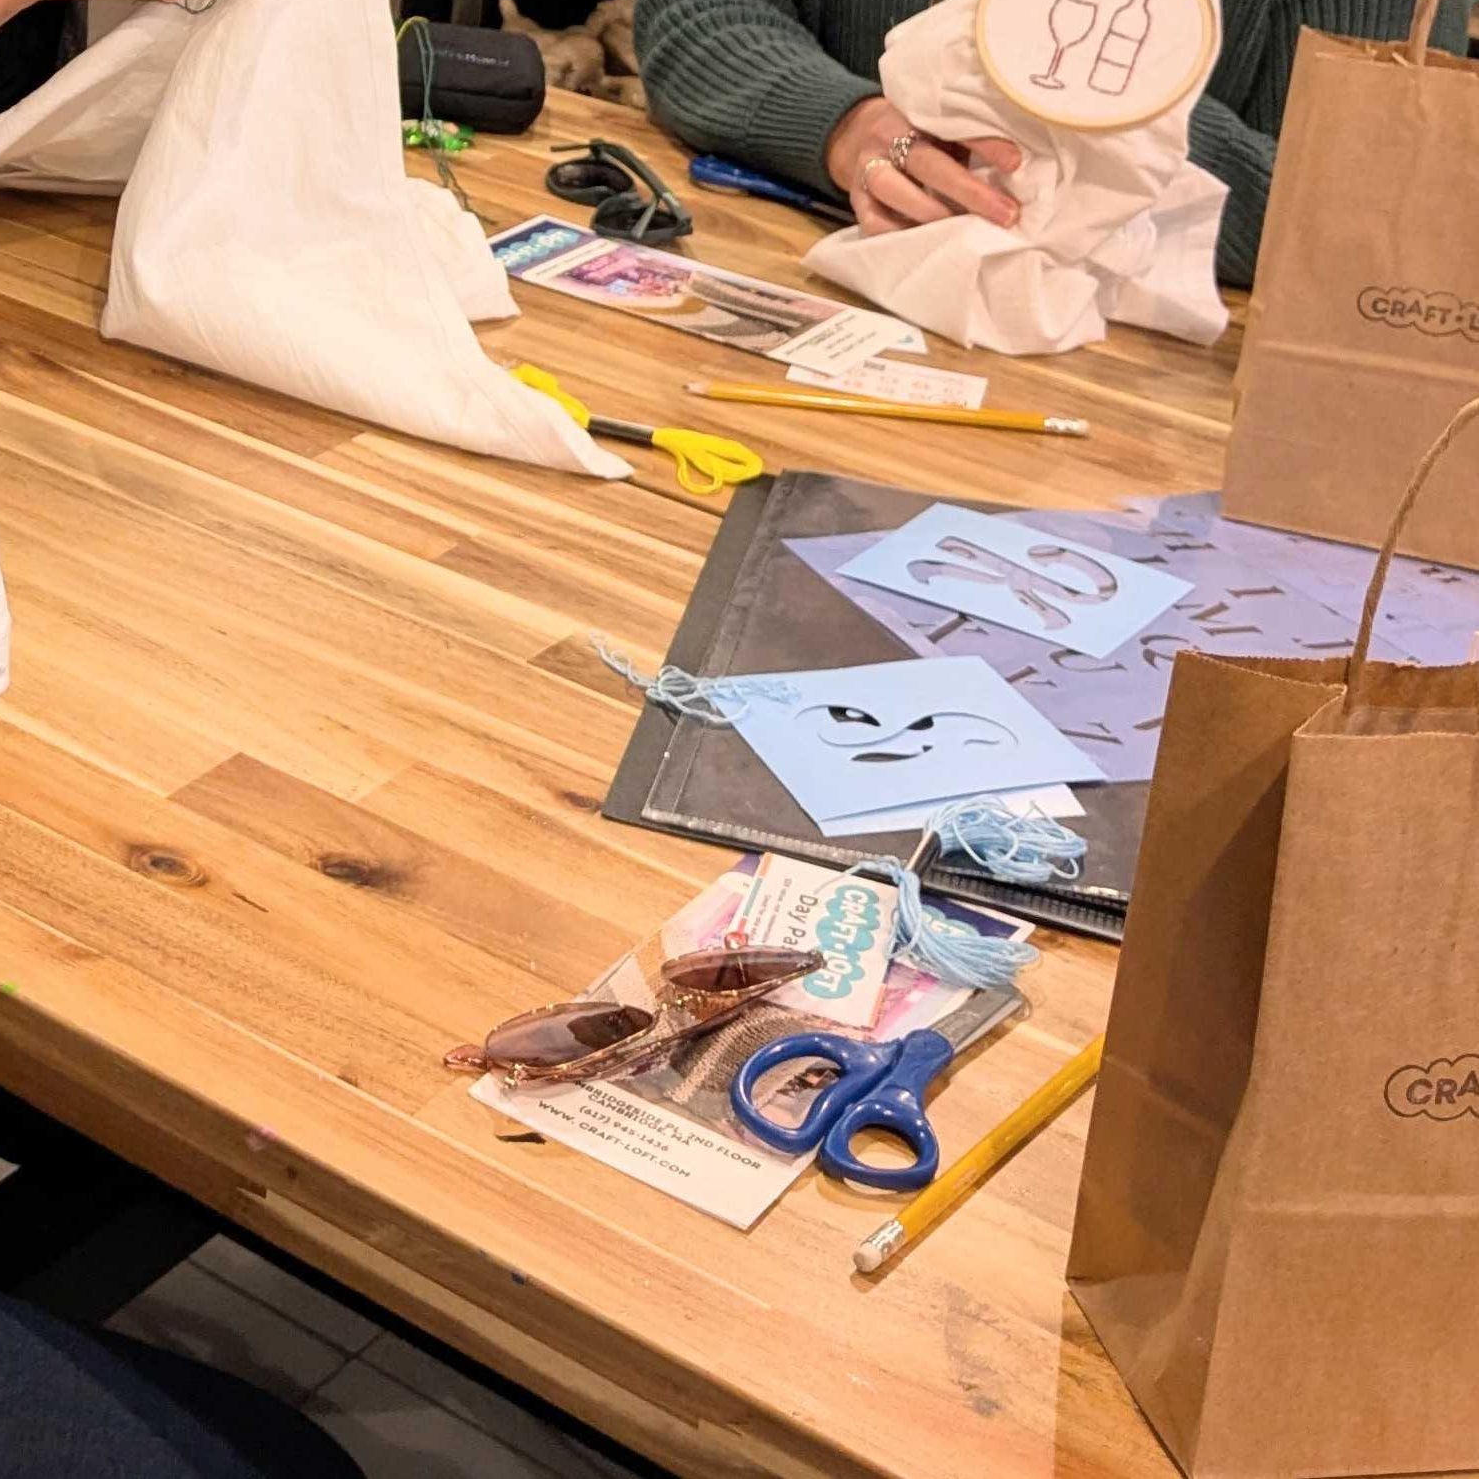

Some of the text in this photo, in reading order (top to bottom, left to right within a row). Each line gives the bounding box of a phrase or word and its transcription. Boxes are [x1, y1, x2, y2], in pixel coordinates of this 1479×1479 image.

[784, 893, 819, 949] Day Pa
[578, 1120, 692, 1179] CRAFT-LOFT.COM
[579, 1104, 669, 1153] (617) 945-1436
[670, 1133, 691, 1147] MA
[686, 1132, 715, 1149] 2ND
[716, 1144, 762, 1171] FLOOR
